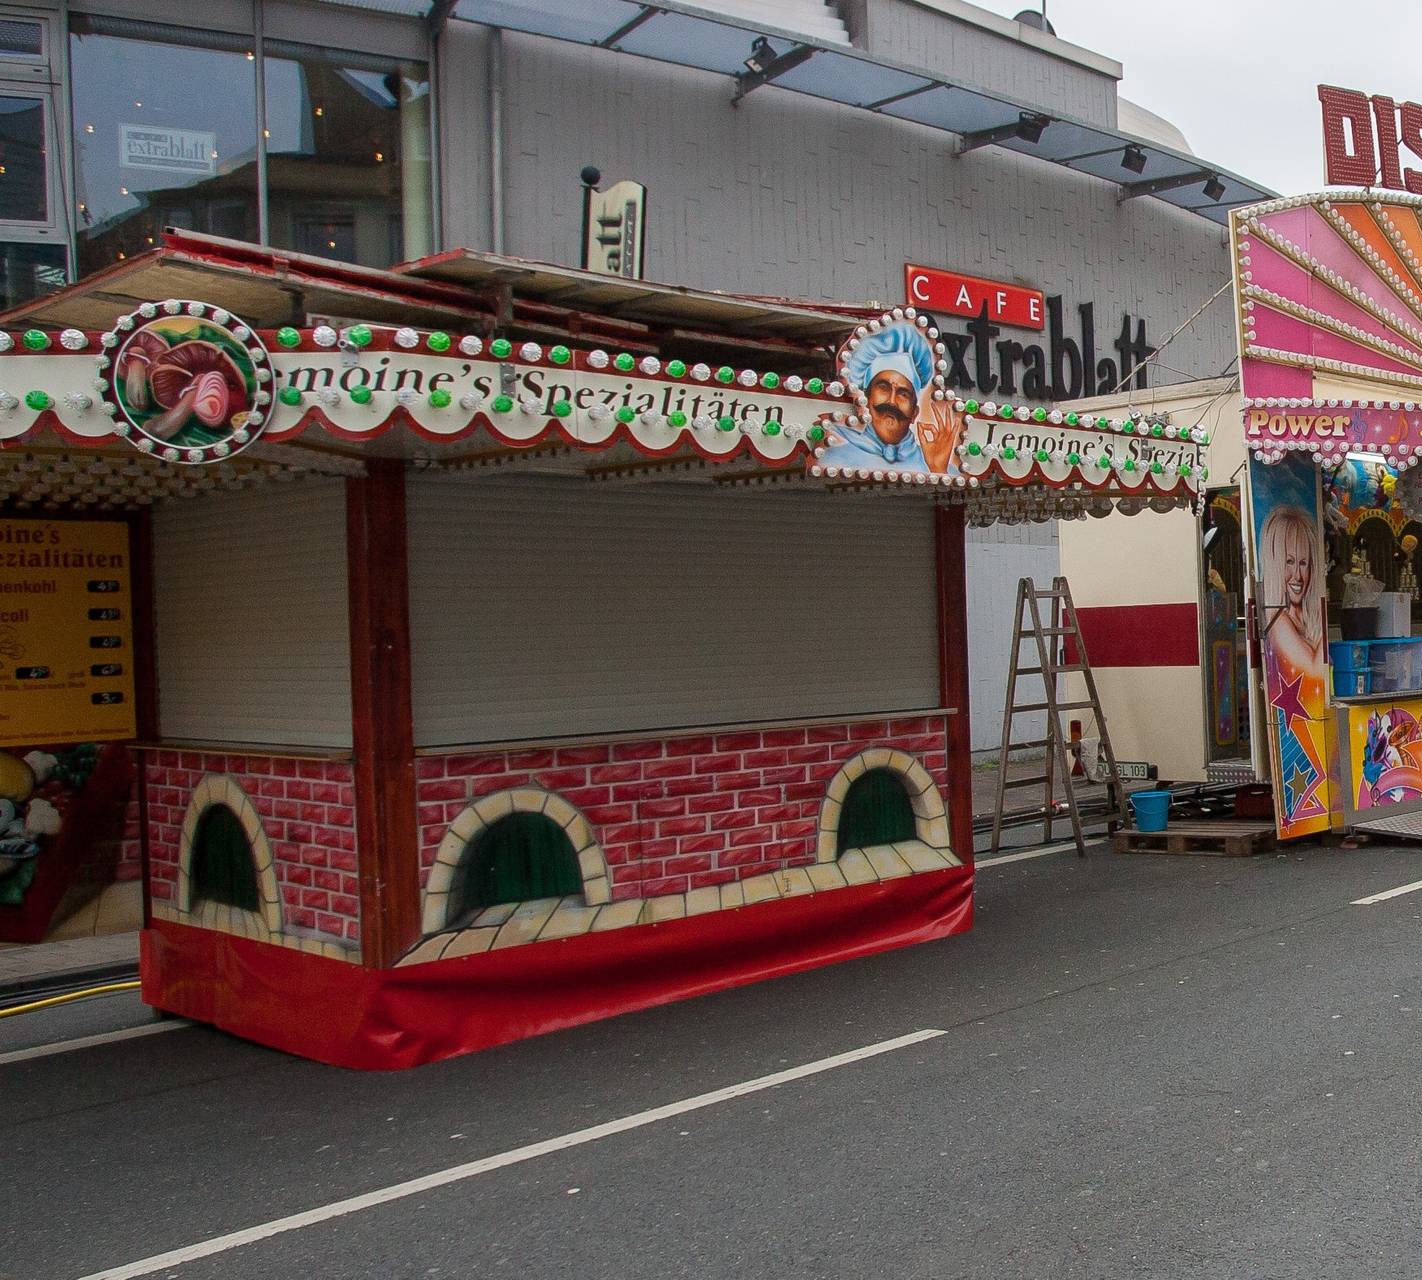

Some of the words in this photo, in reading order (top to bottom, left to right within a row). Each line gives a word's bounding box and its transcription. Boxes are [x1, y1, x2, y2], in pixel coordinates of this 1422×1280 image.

[912, 275, 1041, 322] CAFE
[917, 294, 1158, 401] xtrablatt
[275, 357, 493, 400] moine's
[515, 369, 784, 427] Spezialitäten
[1248, 408, 1351, 437] Power
[984, 423, 1113, 461] Lemoine's
[0, 548, 123, 569] zialitäten
[0, 580, 57, 593] enkohl
[1131, 764, 1146, 777] 103
